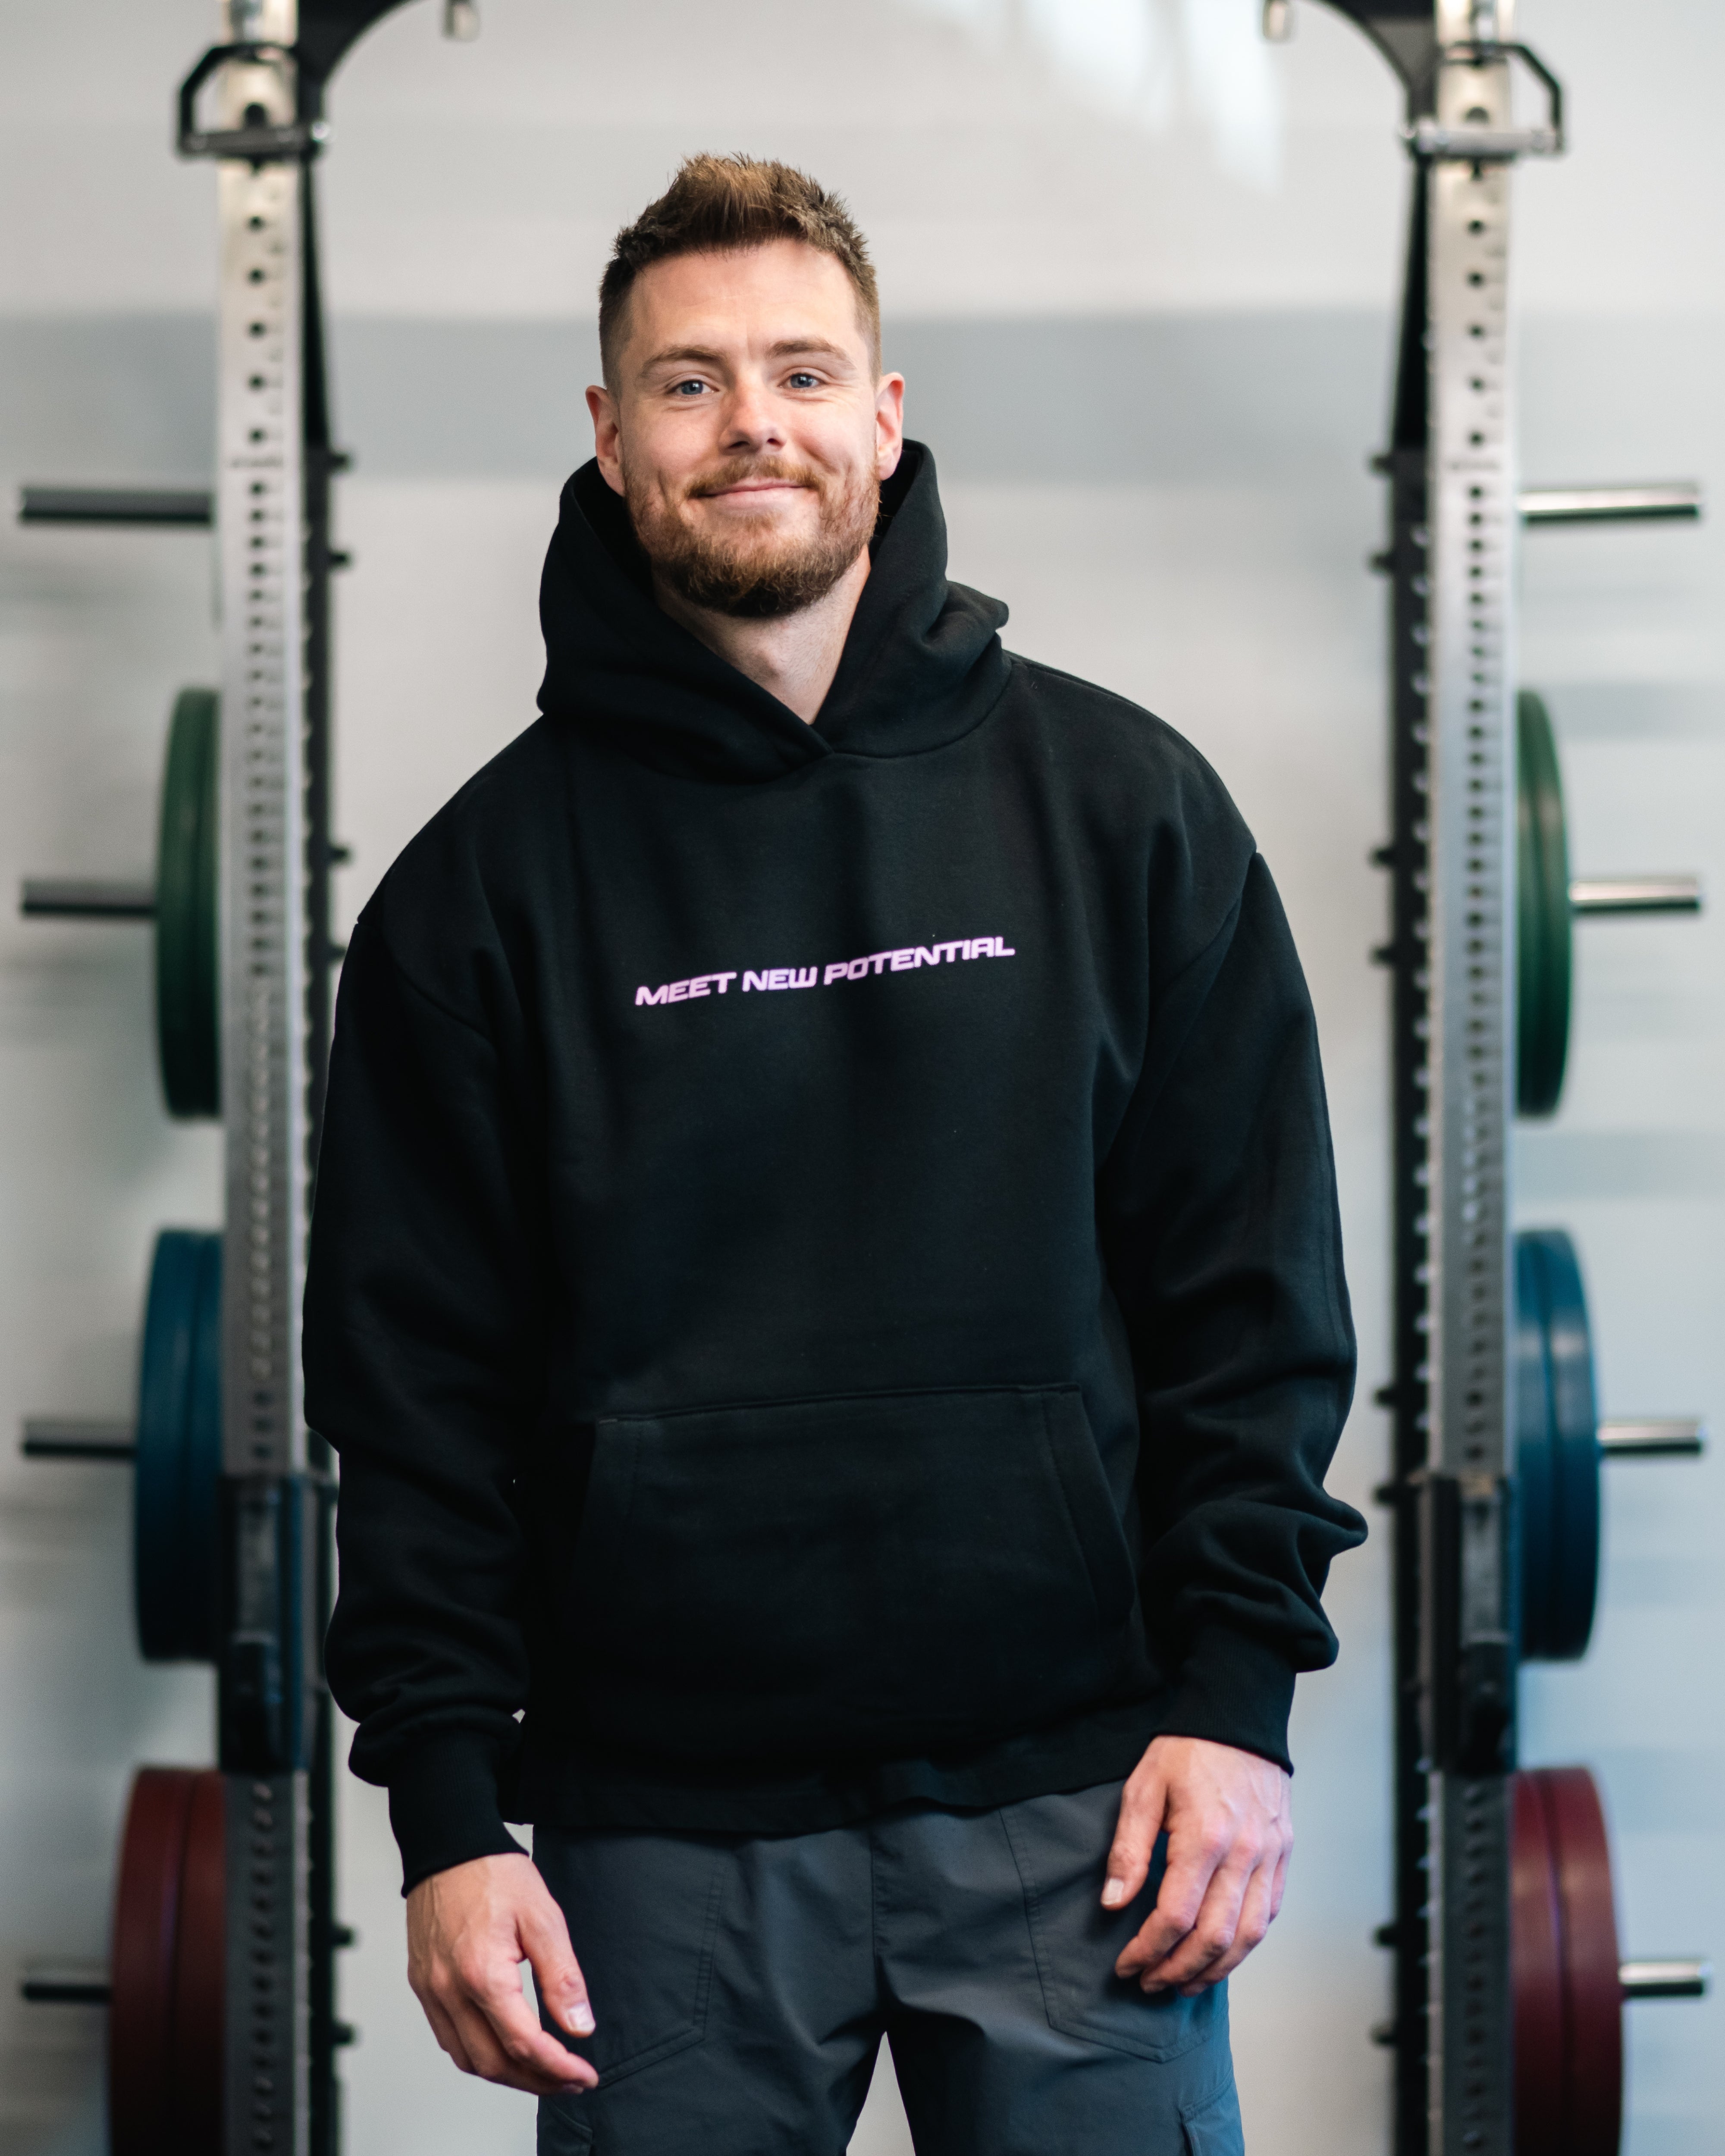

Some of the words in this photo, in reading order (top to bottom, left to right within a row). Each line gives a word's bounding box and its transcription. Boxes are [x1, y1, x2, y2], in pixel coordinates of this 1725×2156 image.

[635, 971, 737, 1006] MEET
[742, 966, 818, 992] NEW
[824, 936, 1015, 985] POTENTIAL
